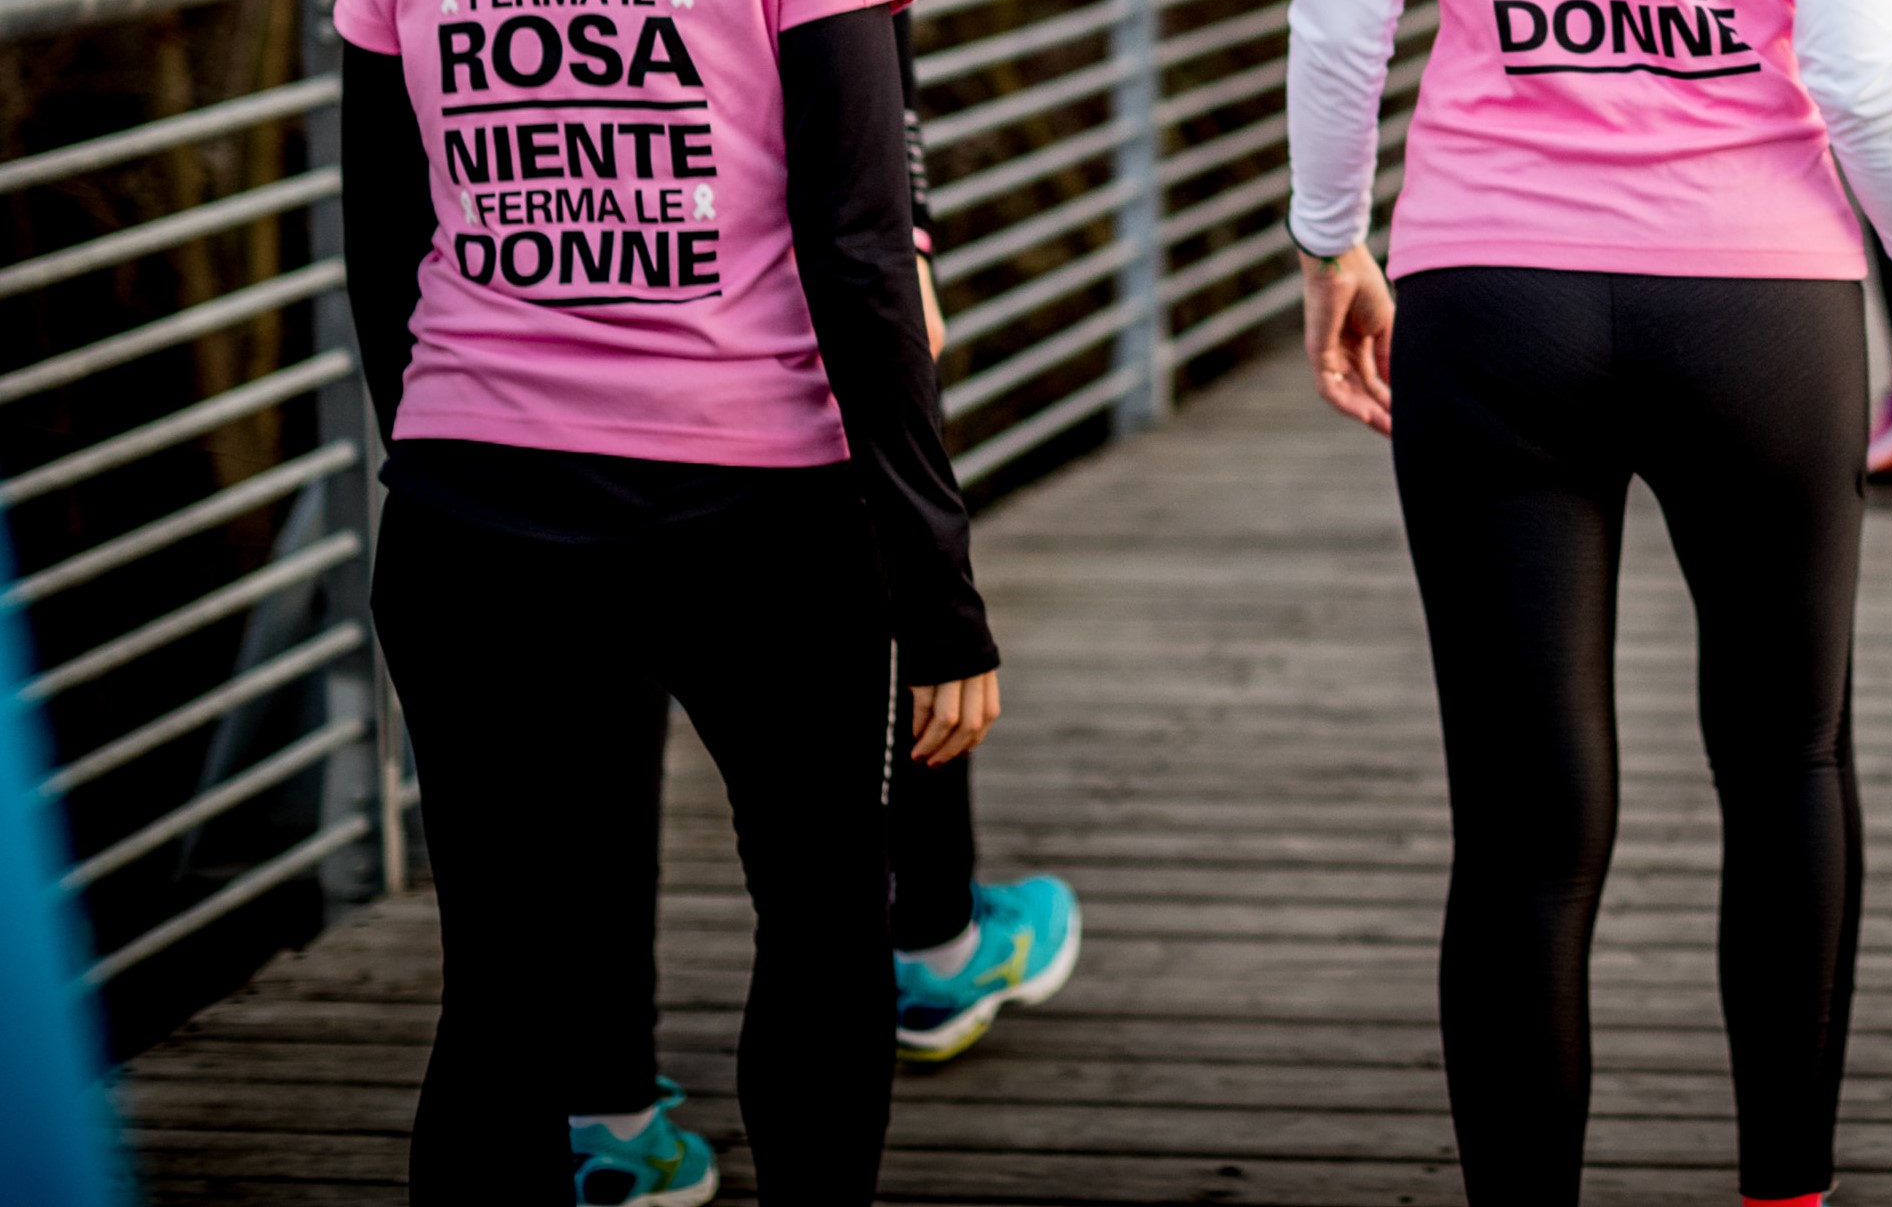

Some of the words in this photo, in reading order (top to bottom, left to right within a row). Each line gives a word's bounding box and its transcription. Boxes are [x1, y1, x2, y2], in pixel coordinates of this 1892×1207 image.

[437, 14, 704, 94] ROSA
[1493, 0, 1753, 58] DONNE
[443, 123, 717, 185] NIENTE
[476, 188, 626, 226] FERMA
[635, 188, 685, 224] LE
[454, 229, 720, 288] DONNE
